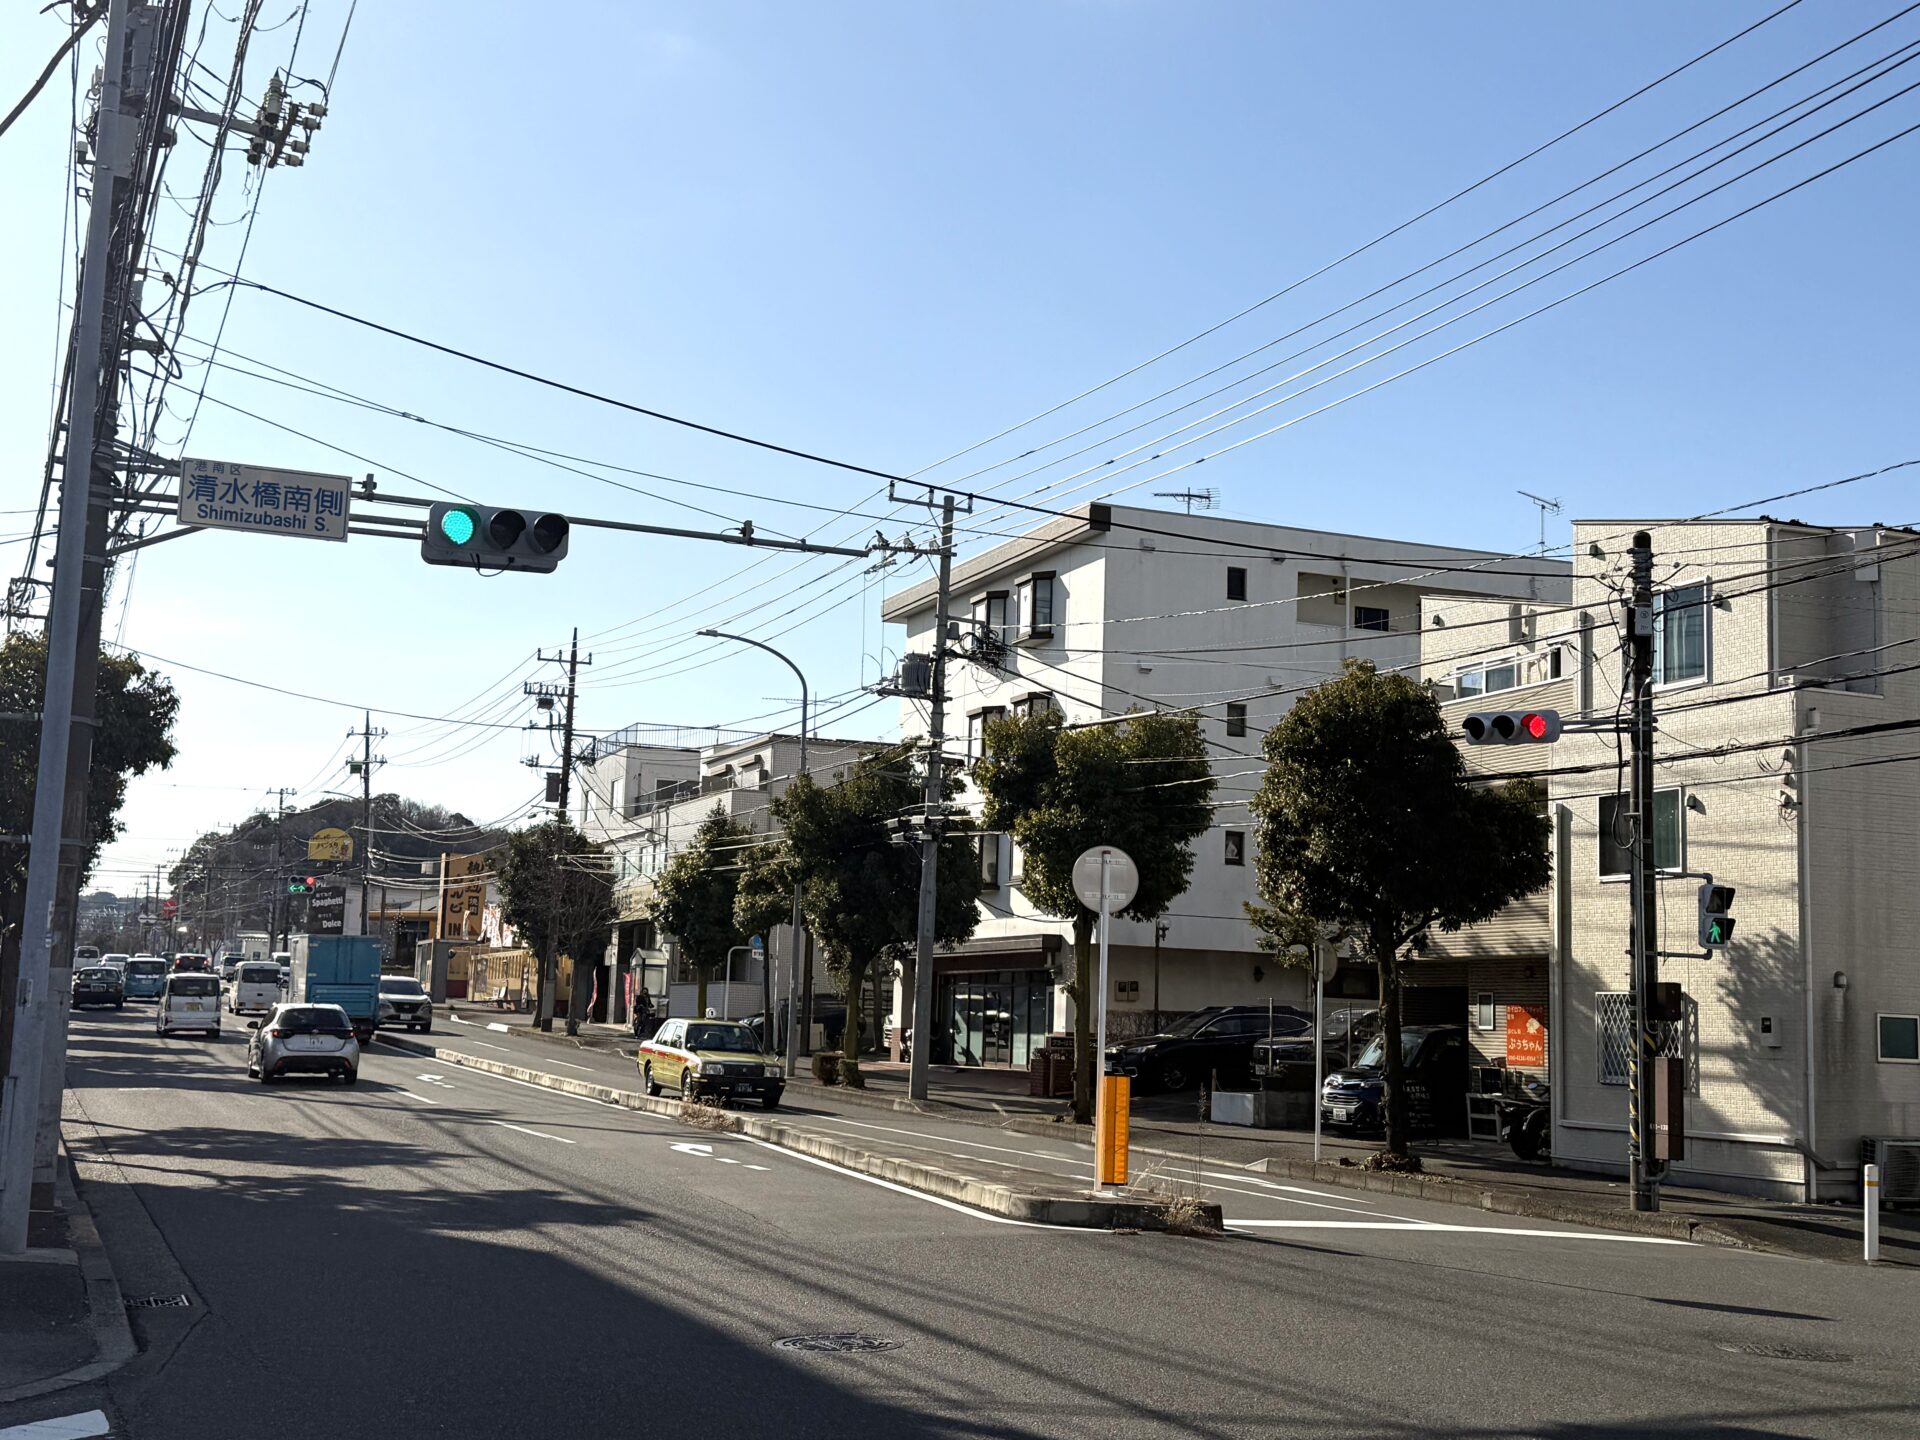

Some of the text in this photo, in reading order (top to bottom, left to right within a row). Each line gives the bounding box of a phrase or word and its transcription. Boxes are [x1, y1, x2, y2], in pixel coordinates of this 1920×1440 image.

[194, 461, 241, 475] 港南区
[187, 474, 344, 517] 清水橋南側
[197, 503, 330, 532] Shimizubashi S.
[312, 896, 343, 907] Spaghetti
[322, 920, 342, 929] Dolce
[447, 922, 462, 937] IN
